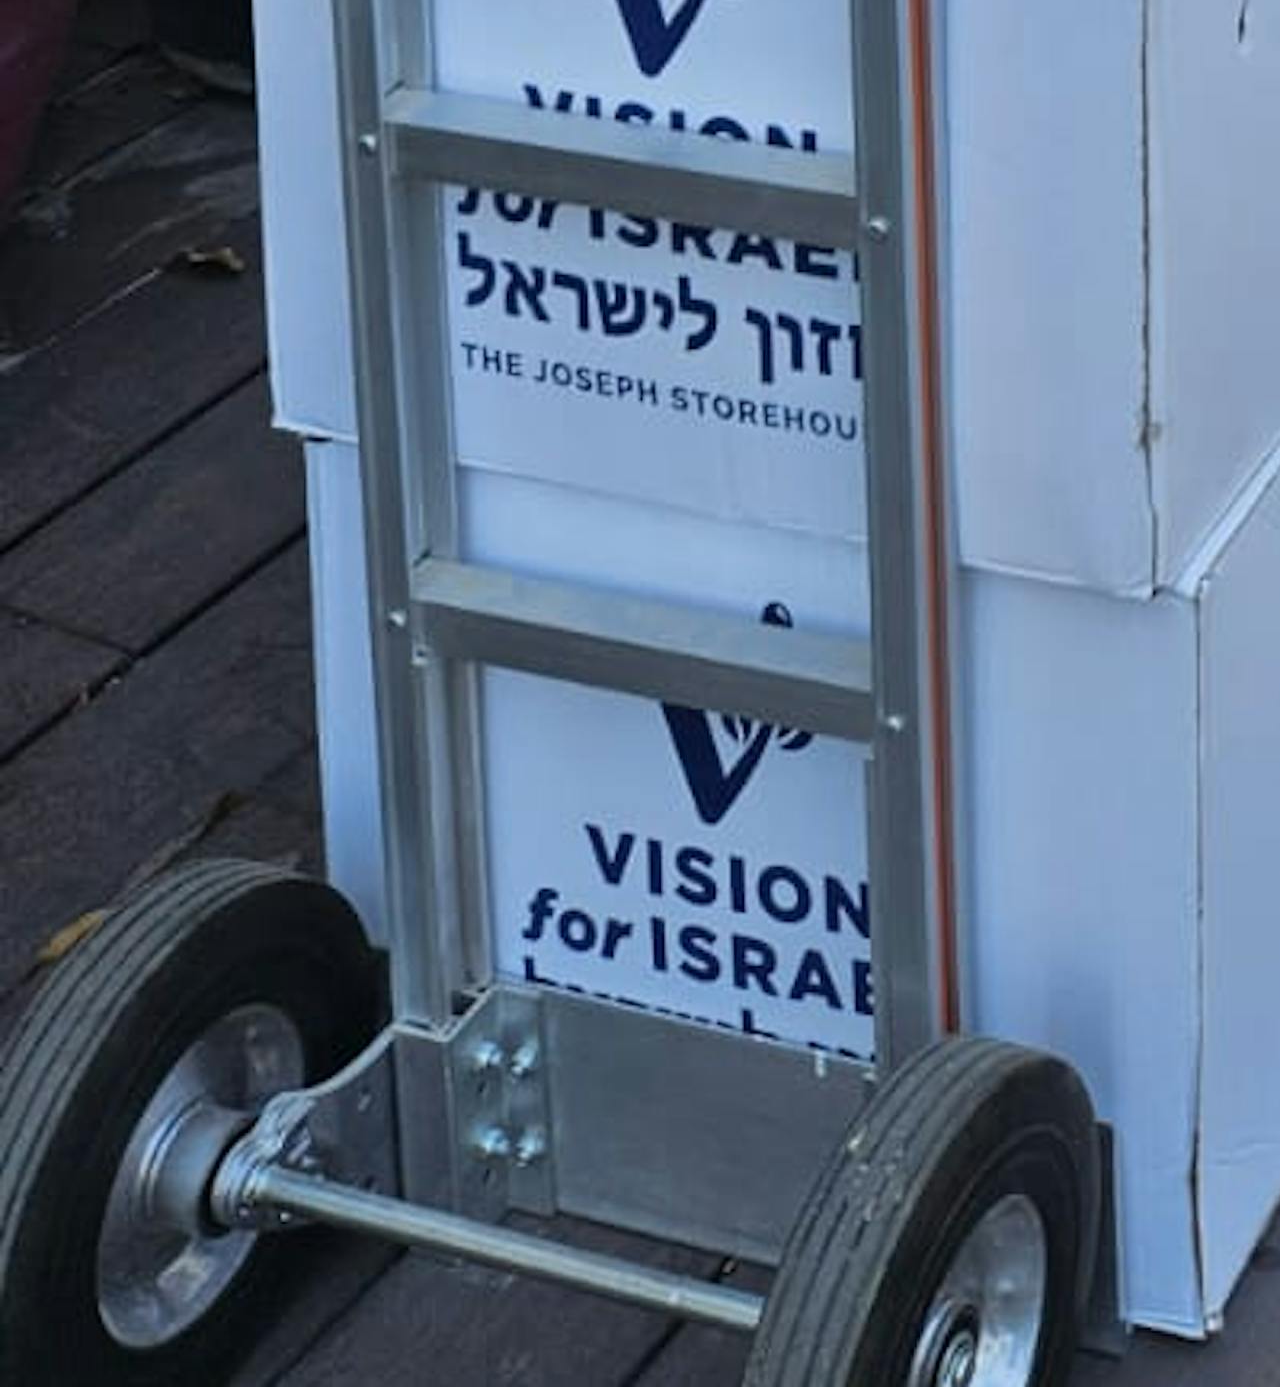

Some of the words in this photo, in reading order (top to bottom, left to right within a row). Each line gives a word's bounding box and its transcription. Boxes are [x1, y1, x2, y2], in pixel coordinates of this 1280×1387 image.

[458, 231, 718, 351] לישראל
[589, 211, 859, 282] ISRAE
[461, 343, 523, 377] THE
[534, 359, 659, 405] JOSEPH
[671, 387, 857, 441] STOREHOU
[585, 823, 870, 938] VISION
[523, 888, 633, 959] for
[651, 917, 873, 1015] ISRA
